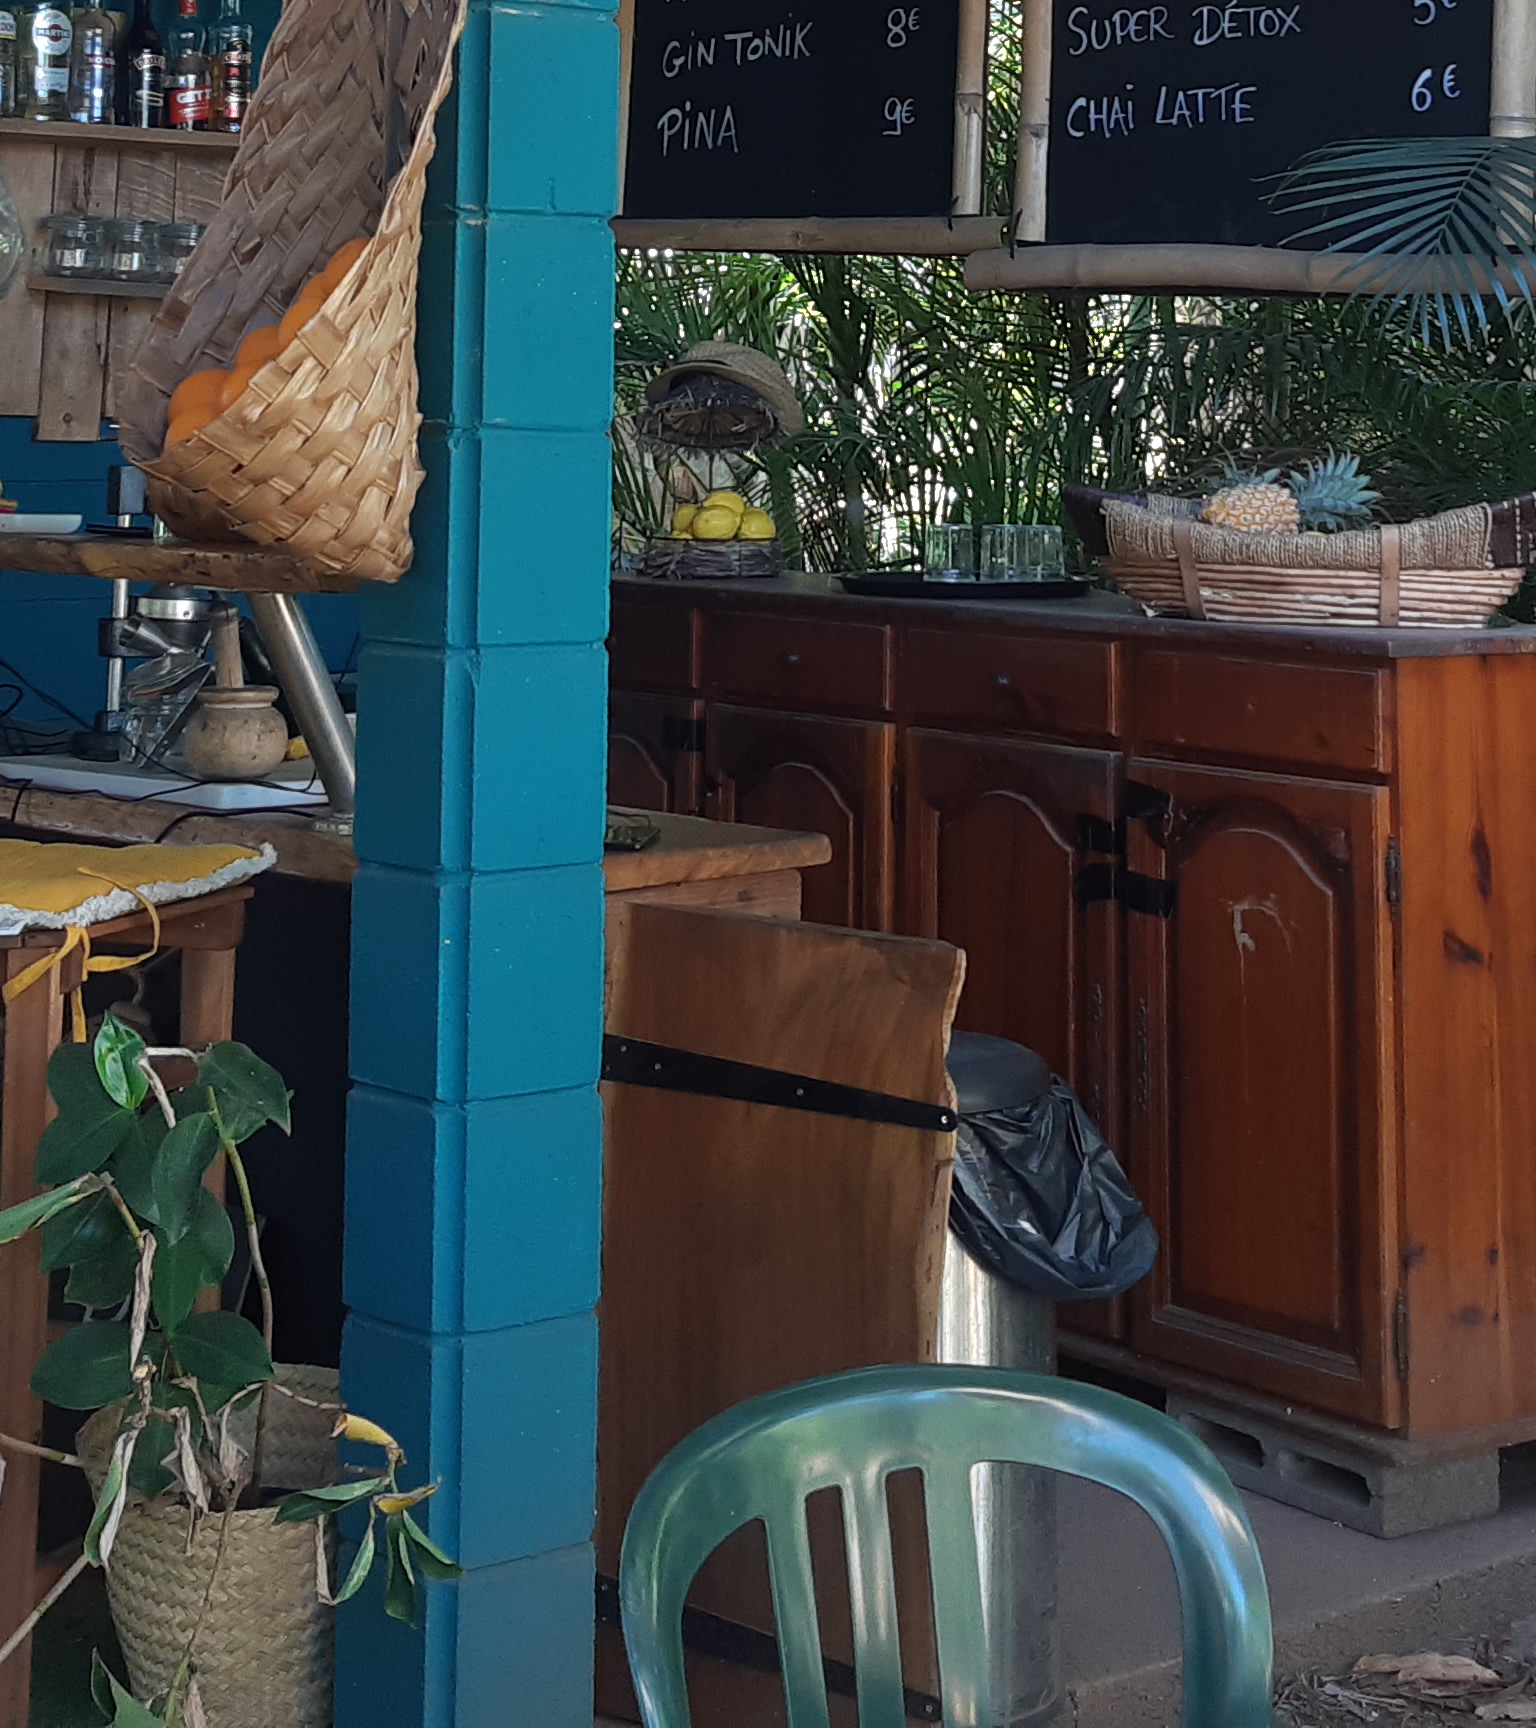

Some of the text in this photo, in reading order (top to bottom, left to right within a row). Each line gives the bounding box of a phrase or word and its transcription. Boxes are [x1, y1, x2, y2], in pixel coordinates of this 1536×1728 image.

[887, 7, 921, 48] 8€
[1067, 6, 1175, 55] SUPER
[1191, 0, 1301, 46] DÉTOX
[882, 96, 916, 135] 9€
[1155, 82, 1258, 128] LATTE
[1410, 63, 1461, 112] 6€
